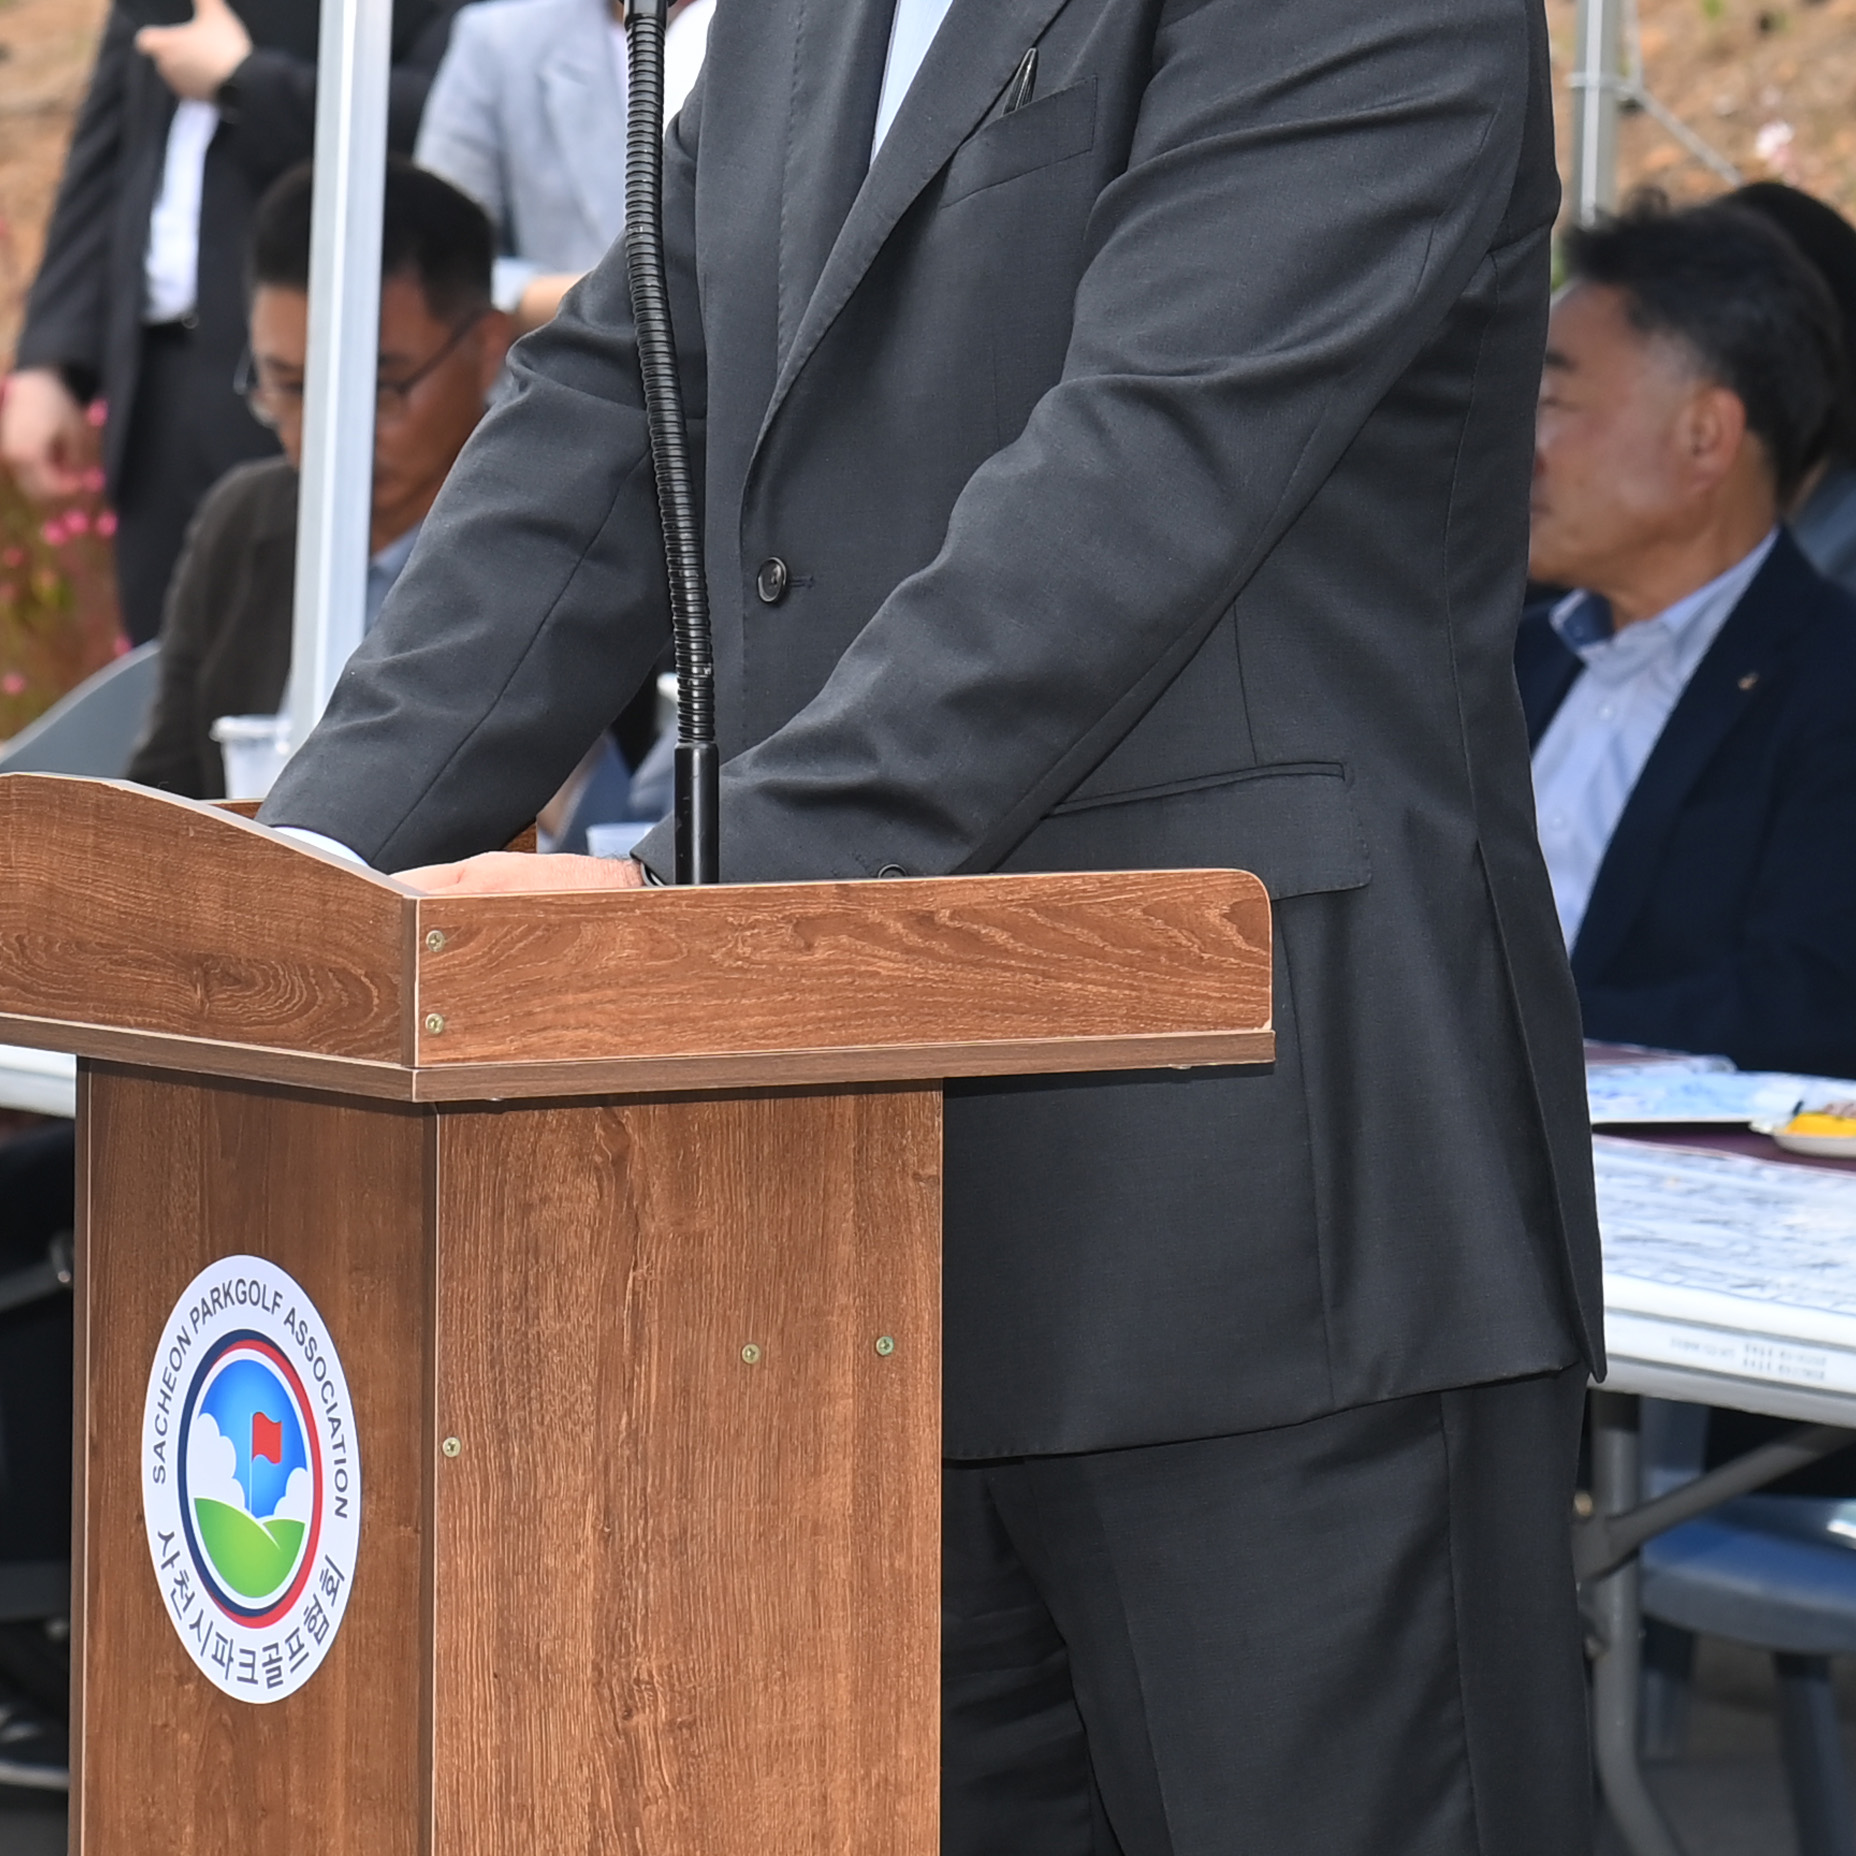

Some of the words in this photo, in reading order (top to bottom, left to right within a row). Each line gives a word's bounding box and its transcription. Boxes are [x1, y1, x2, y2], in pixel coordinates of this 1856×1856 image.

[152, 1326, 191, 1485] SACHEON
[188, 1278, 284, 1334] PARKGOLF
[283, 1307, 349, 1519] ASSOCIATION
